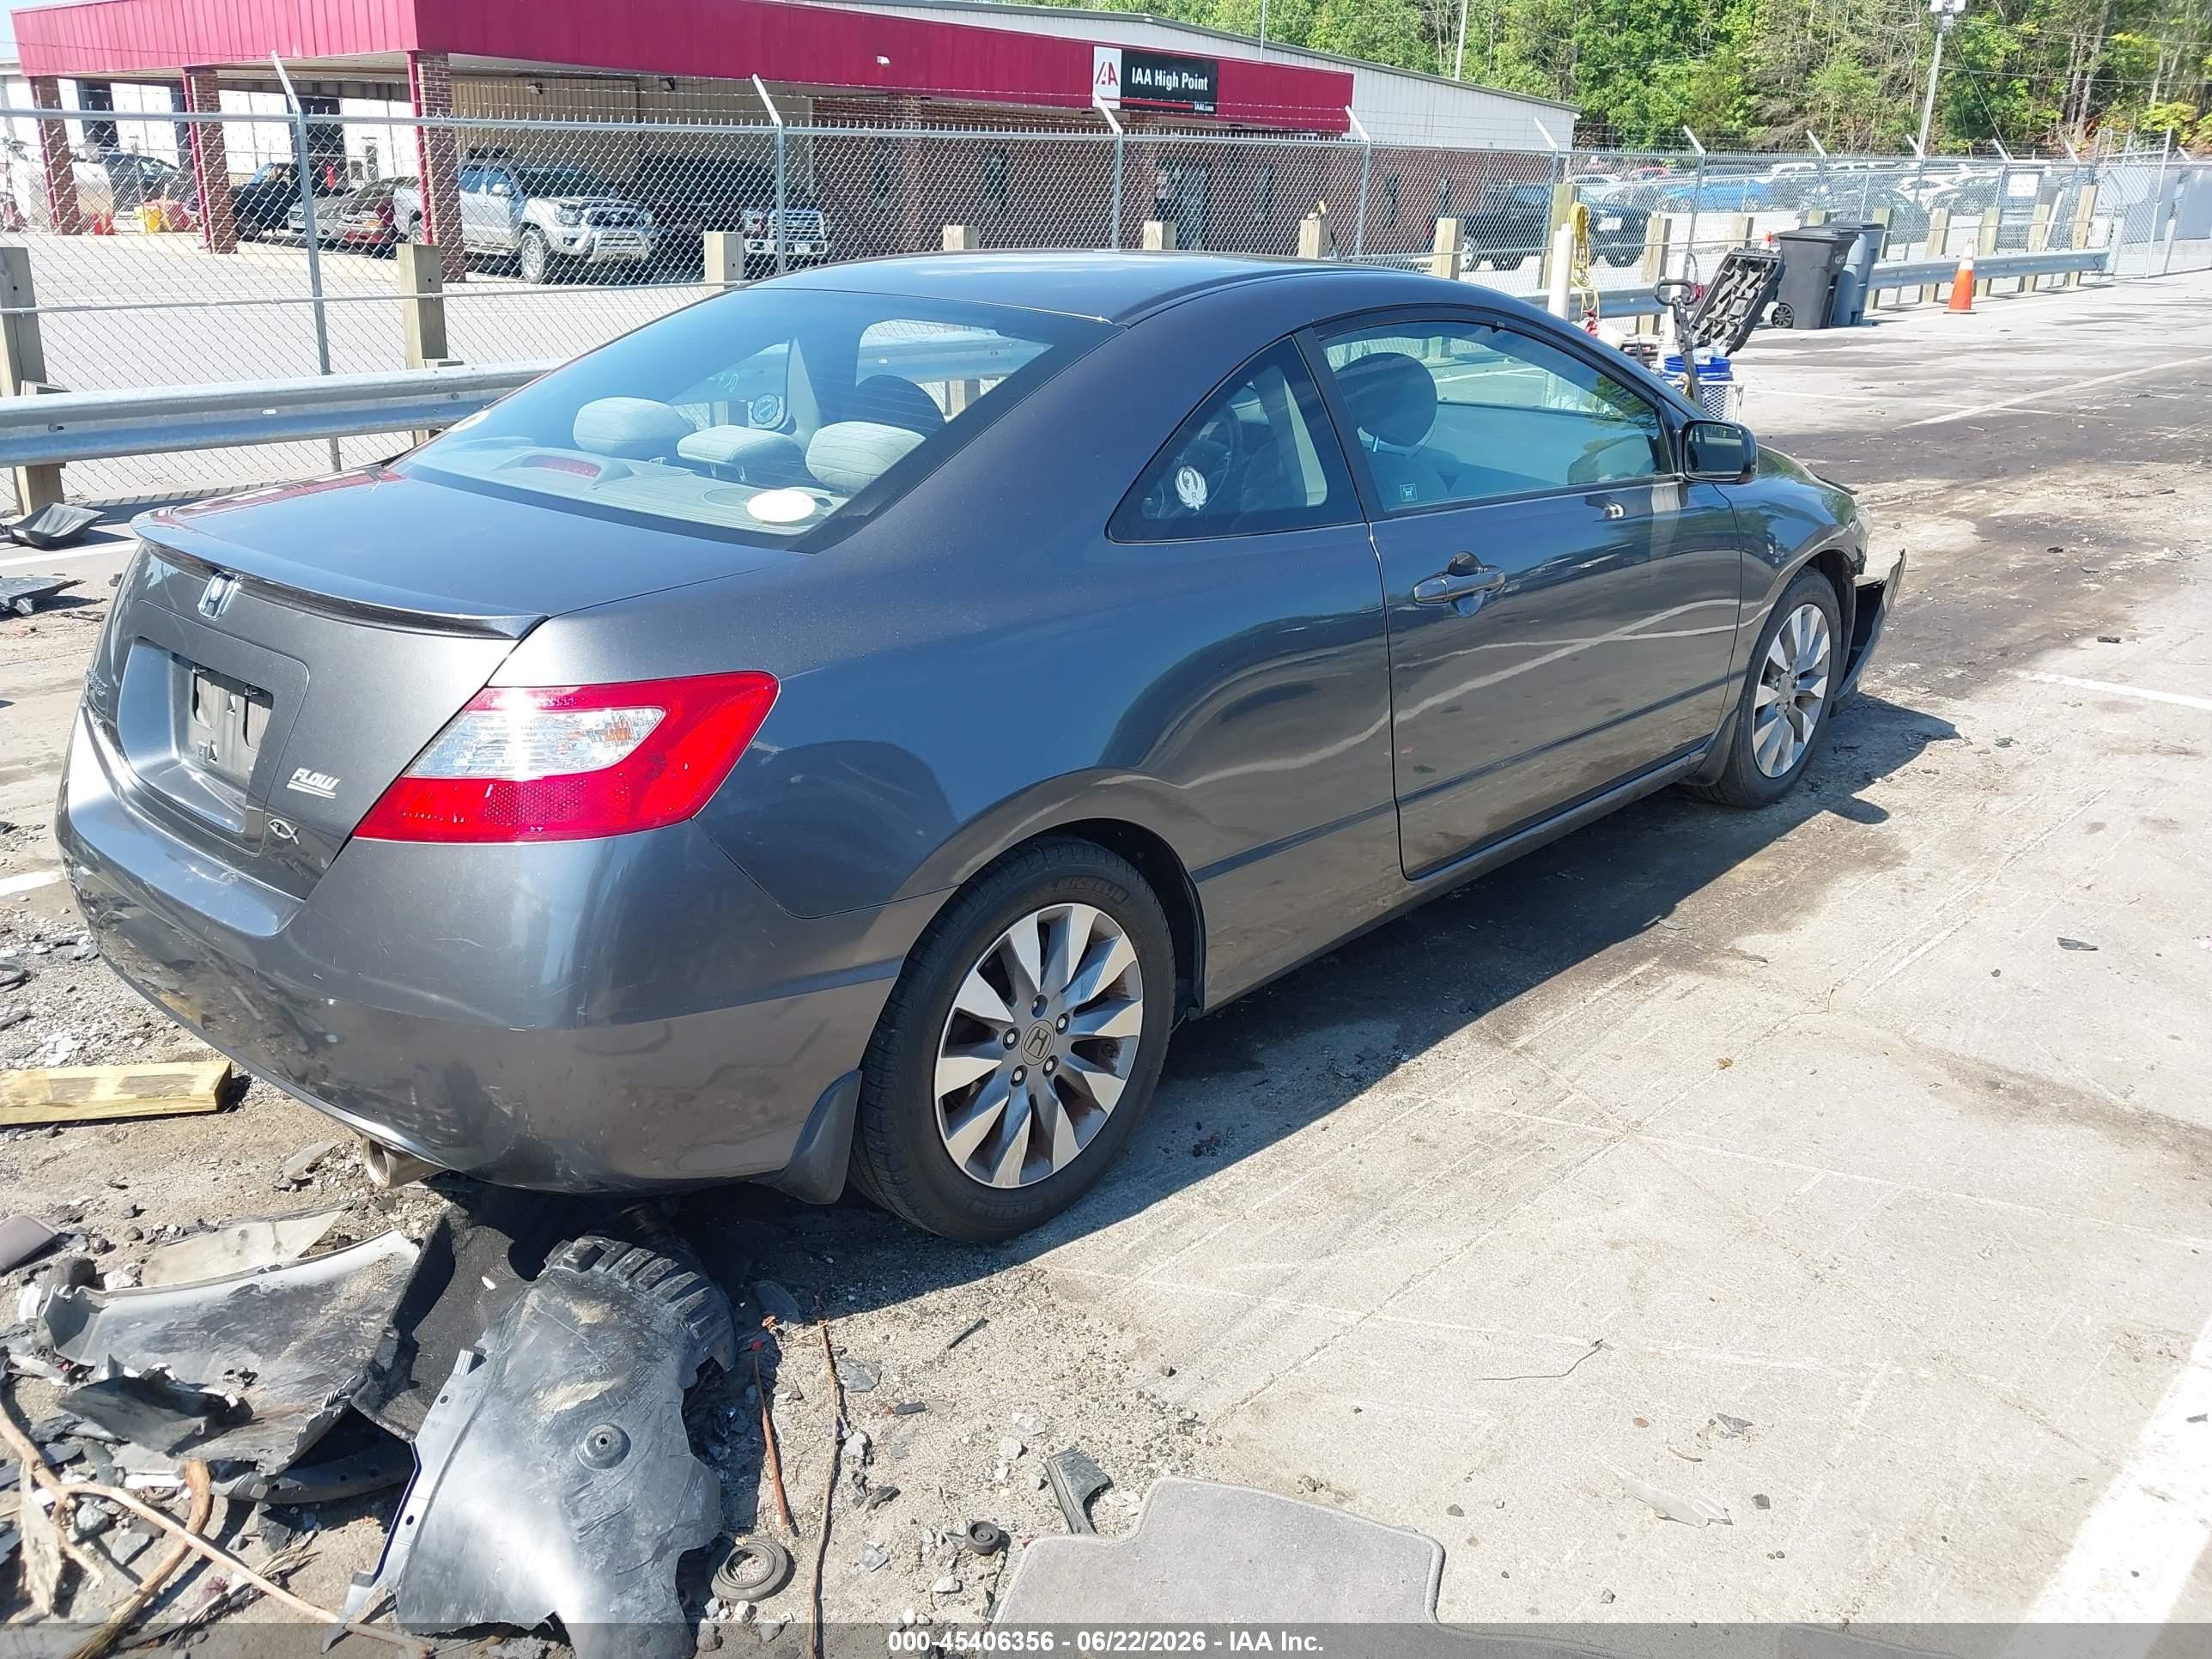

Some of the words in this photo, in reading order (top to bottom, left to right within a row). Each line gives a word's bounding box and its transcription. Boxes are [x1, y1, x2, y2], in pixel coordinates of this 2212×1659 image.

[1132, 67, 1152, 85] IAA
[1155, 70, 1178, 91] High
[1182, 72, 1208, 91] Point
[291, 768, 341, 791] FLOW
